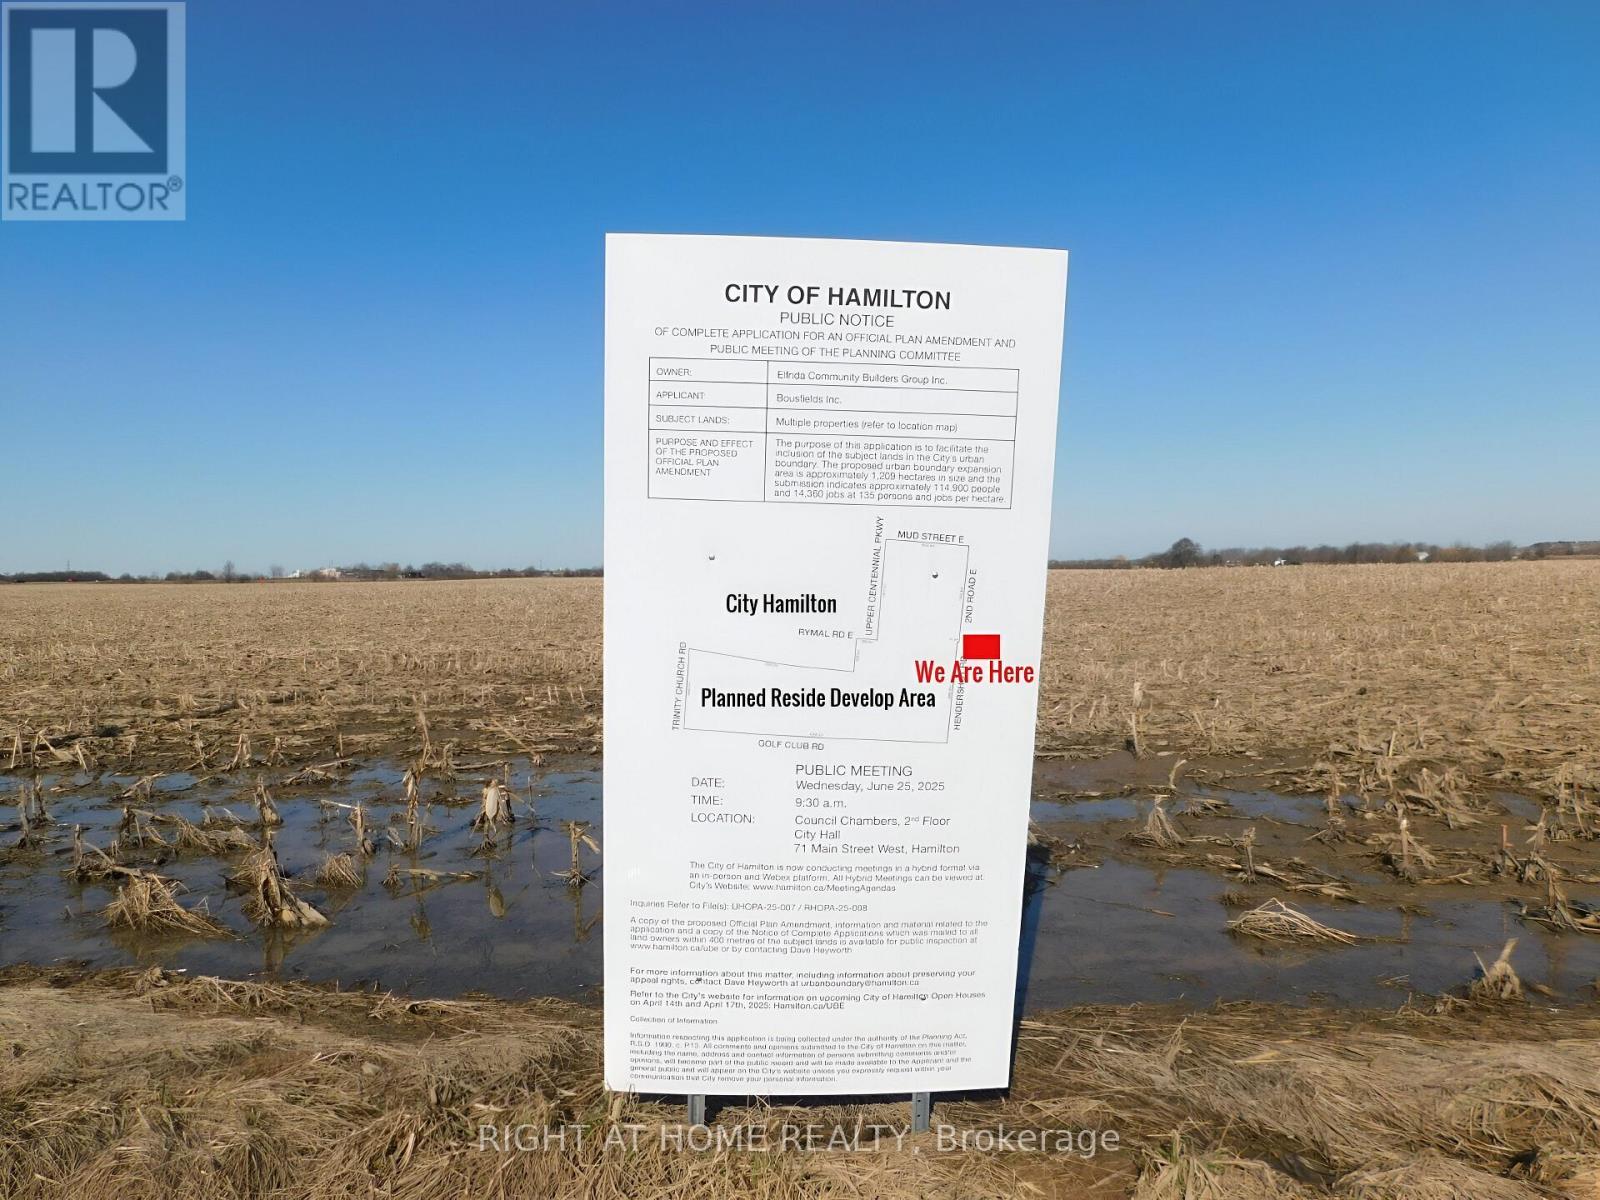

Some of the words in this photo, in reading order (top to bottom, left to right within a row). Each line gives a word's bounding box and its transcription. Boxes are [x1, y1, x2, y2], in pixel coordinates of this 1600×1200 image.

[724, 283, 779, 303] CITY
[787, 285, 820, 305] OF
[828, 286, 950, 310] HAMILTON
[780, 311, 835, 326] PUBLIC
[839, 313, 894, 327] NOTICE
[654, 326, 669, 336] OF
[671, 327, 729, 338] COMPLETE
[731, 328, 800, 343] APPLICATION
[803, 330, 825, 343] FOR
[826, 332, 843, 345] AN
[845, 332, 892, 344] OFFICIAL
[895, 334, 923, 344] PLAN
[924, 335, 992, 347] AMENDMENT
[993, 338, 1016, 351] AND
[710, 344, 749, 354] PUBLIC
[751, 345, 799, 355] MEETING
[800, 346, 816, 359] OF
[818, 347, 840, 357] THE
[842, 347, 896, 359] PLANNING
[899, 350, 960, 362] COMMITTEE
[807, 369, 860, 383] Community
[862, 372, 899, 383] Builders
[900, 374, 930, 385] Group
[655, 412, 696, 424] SUBJECT
[775, 416, 812, 430] Multiple
[813, 417, 859, 431] properties
[886, 421, 896, 430] to
[896, 420, 933, 432] location
[655, 437, 698, 447] PURPOSE
[699, 438, 719, 447] AND
[720, 439, 754, 448] EFFECT
[775, 438, 792, 448] The
[794, 439, 831, 449] purpose
[833, 440, 843, 449] of
[845, 440, 861, 451] this
[863, 440, 912, 452] application
[914, 442, 922, 453] is
[935, 443, 973, 454] facilitate
[974, 445, 989, 455] the
[655, 446, 668, 456] OF
[668, 447, 686, 456] THE
[688, 448, 738, 458] PROPOSED
[655, 457, 694, 467] OFFICIAL
[695, 457, 719, 467] PLAN
[655, 467, 711, 476] AMENDMENT
[875, 516, 884, 543] PKWY
[898, 531, 919, 540] MUD
[922, 532, 955, 542] STREET
[868, 545, 881, 603] CENTENNIAL
[967, 576, 976, 602] ROAD
[865, 606, 874, 635] UPPER
[799, 628, 829, 637] RYMAL
[679, 641, 686, 654] RD
[676, 657, 685, 695] CHURCH
[672, 698, 682, 730] TRINITY
[758, 740, 782, 749] GOLF
[785, 741, 809, 750] CLUB
[795, 764, 846, 776] PUBLIC
[850, 764, 912, 776] MEETING
[691, 776, 724, 788] DATE:
[795, 778, 863, 793] Wednesday,
[866, 781, 894, 791] June
[917, 781, 945, 791] 2025
[690, 794, 723, 805] TIME:
[795, 797, 820, 808] 9:30
[690, 811, 755, 824] LOCATION:
[794, 814, 837, 825] Council
[840, 815, 900, 826] Chambers,
[922, 815, 951, 826] Floor
[794, 829, 816, 841] City
[819, 829, 841, 842] Hall
[793, 843, 806, 853] 71
[811, 843, 838, 853] Main
[841, 843, 874, 854] Street
[877, 843, 907, 855] West,
[911, 843, 960, 854] Hamilton
